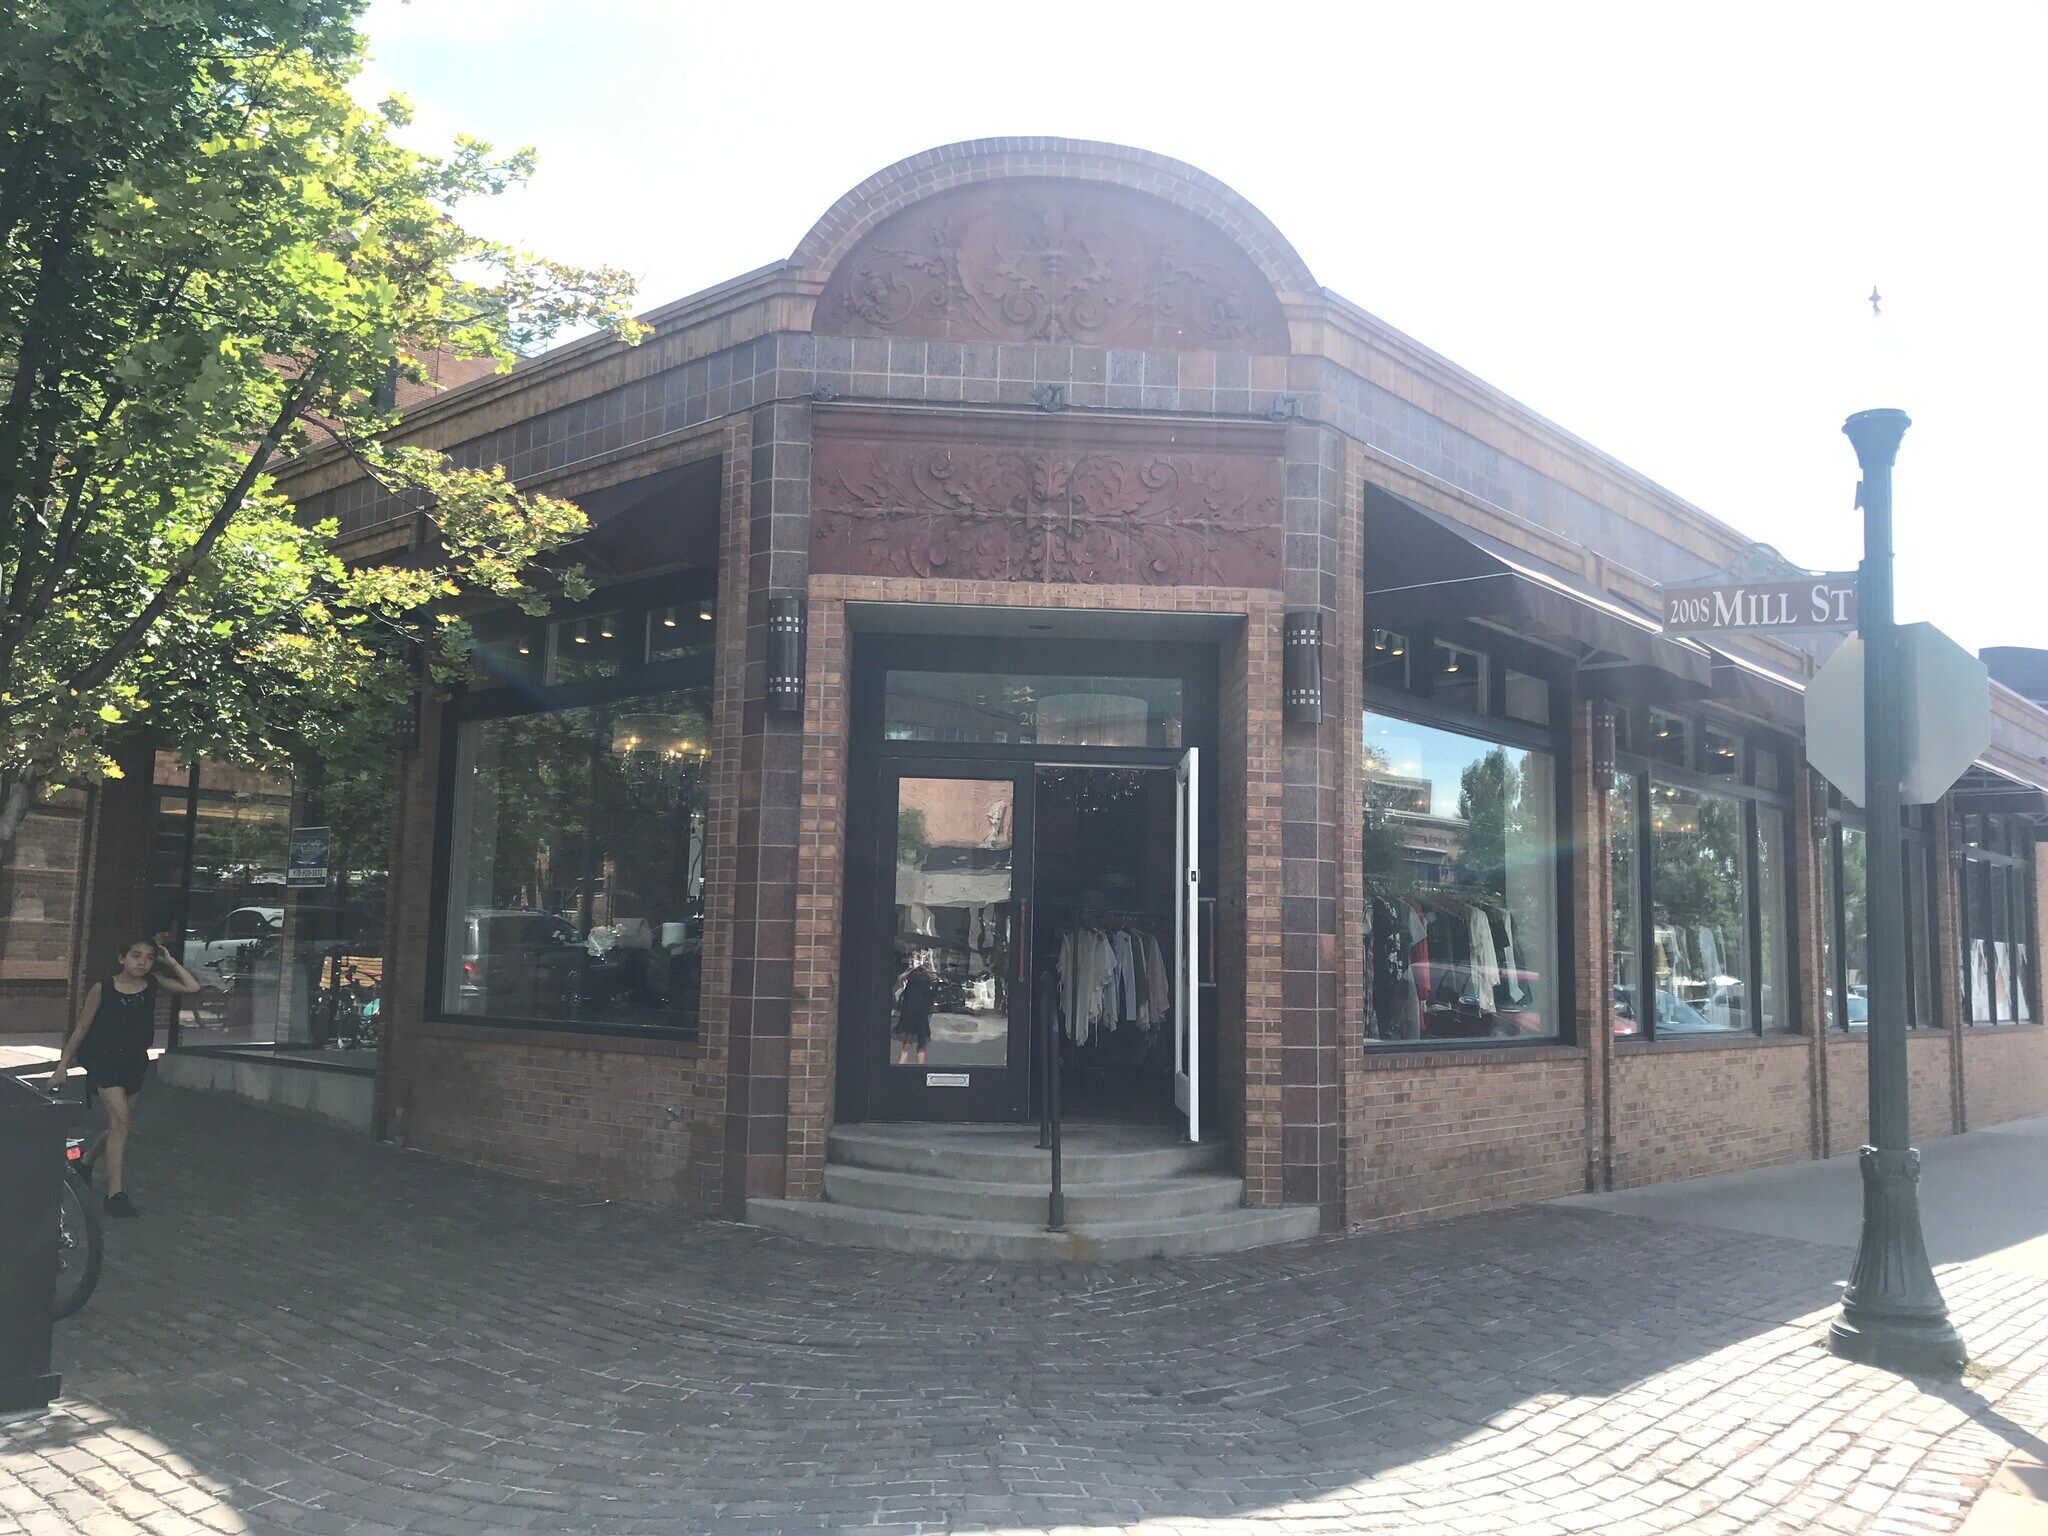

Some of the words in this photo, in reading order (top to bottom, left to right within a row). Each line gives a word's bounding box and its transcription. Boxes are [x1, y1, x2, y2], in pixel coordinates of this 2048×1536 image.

[1670, 597, 1710, 624] 200S
[1712, 589, 1797, 627] MILL
[1811, 585, 1853, 623] ST
[1020, 711, 1048, 726] 205
